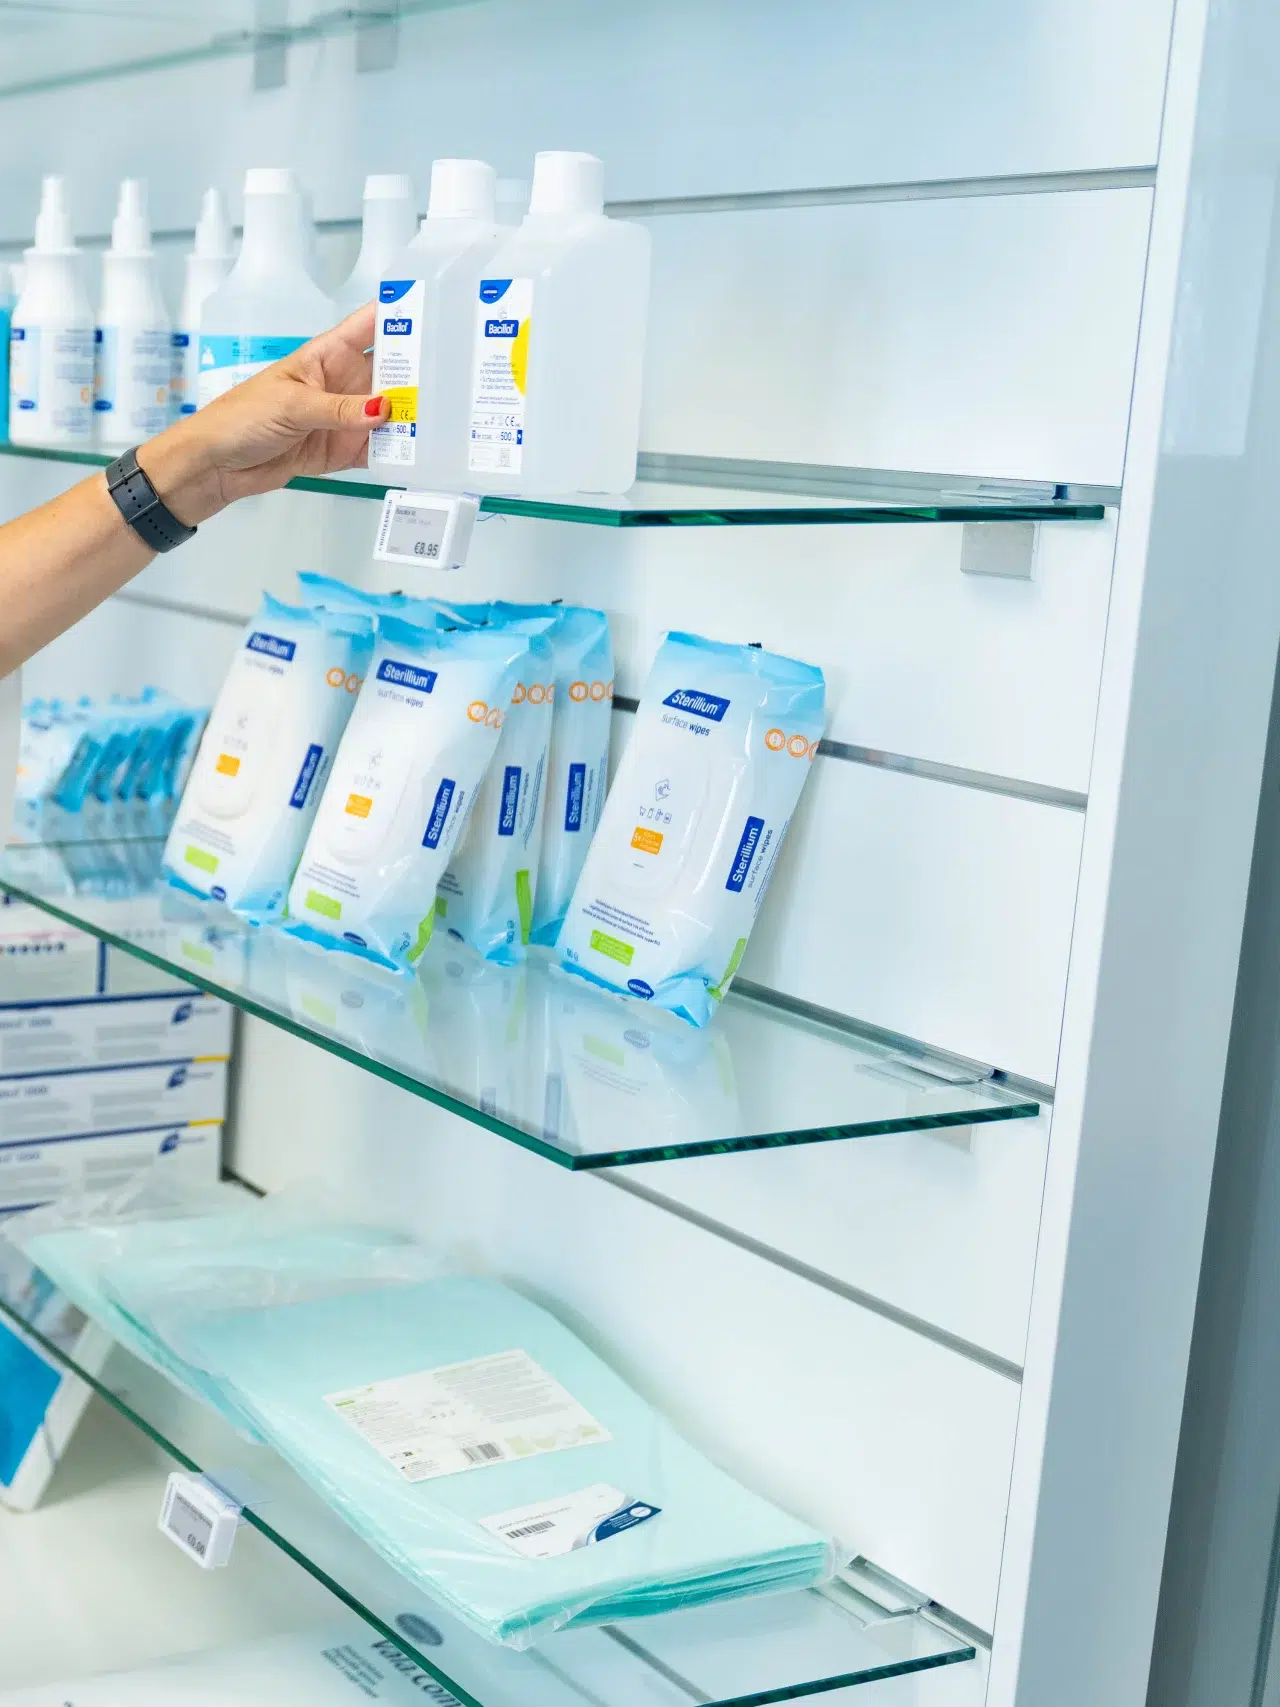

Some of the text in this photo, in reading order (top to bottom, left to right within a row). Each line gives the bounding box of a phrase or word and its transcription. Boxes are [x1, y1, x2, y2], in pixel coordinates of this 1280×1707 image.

[386, 322, 409, 333] Bacillol
[487, 323, 515, 335] Bacillol
[414, 541, 439, 557] €8.95
[383, 663, 429, 689] Sterillium
[671, 690, 719, 716] Sterillium
[661, 712, 711, 737] surface wipes
[427, 787, 451, 842] Sterillium
[731, 827, 759, 884] Sterillium
[747, 829, 773, 889] surface wipes
